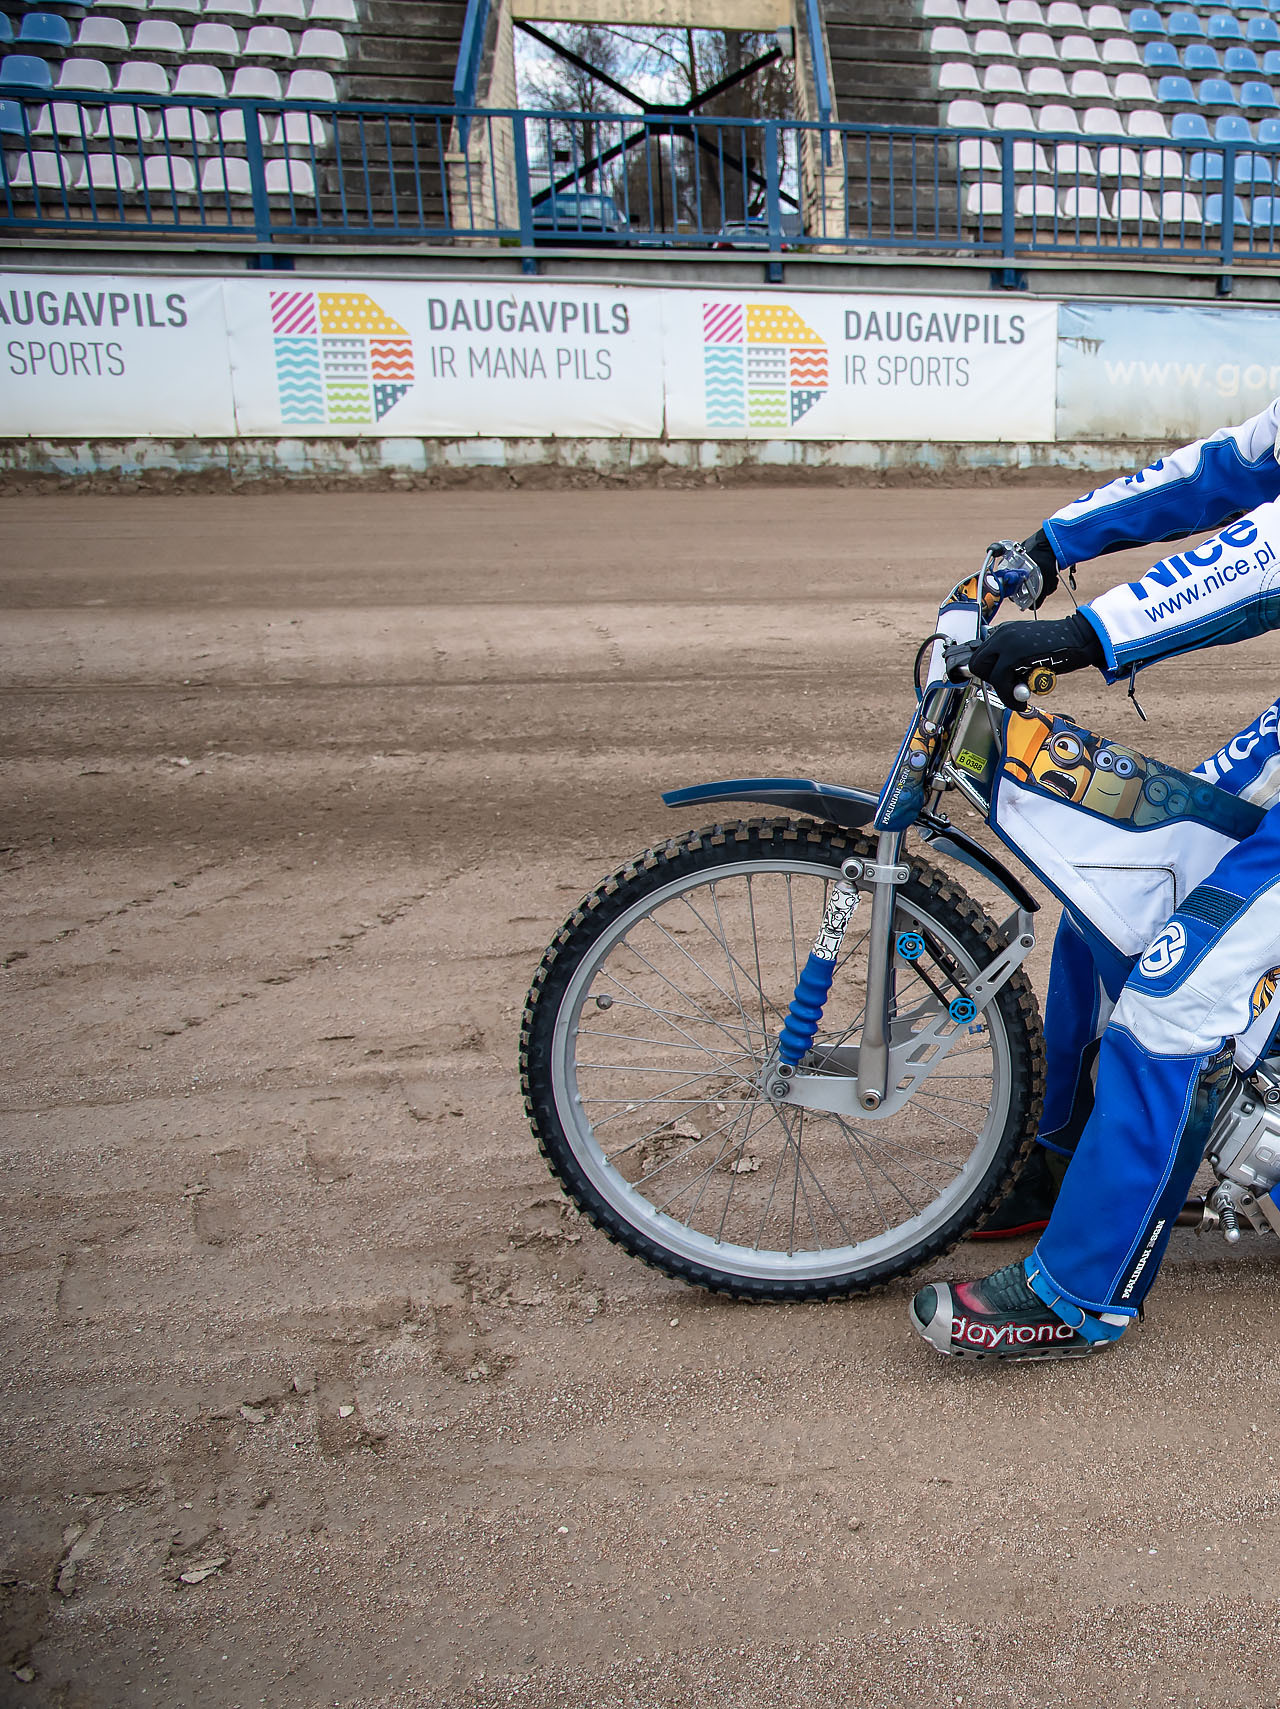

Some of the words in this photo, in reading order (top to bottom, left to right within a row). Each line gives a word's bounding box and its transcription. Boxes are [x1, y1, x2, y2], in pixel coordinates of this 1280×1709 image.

[428, 298, 630, 335] DAUGAVPILS
[845, 310, 1025, 345] DAUGAVPILS
[7, 340, 125, 377] SPORTS
[431, 346, 456, 378] IR
[469, 346, 547, 379] MANA
[556, 348, 612, 381] PILS
[845, 354, 867, 385] IR
[877, 355, 970, 387] SPORTS
[1144, 541, 1276, 623] www.nice.pl
[966, 758, 983, 771] 0388
[951, 1316, 1075, 1348] daytona
